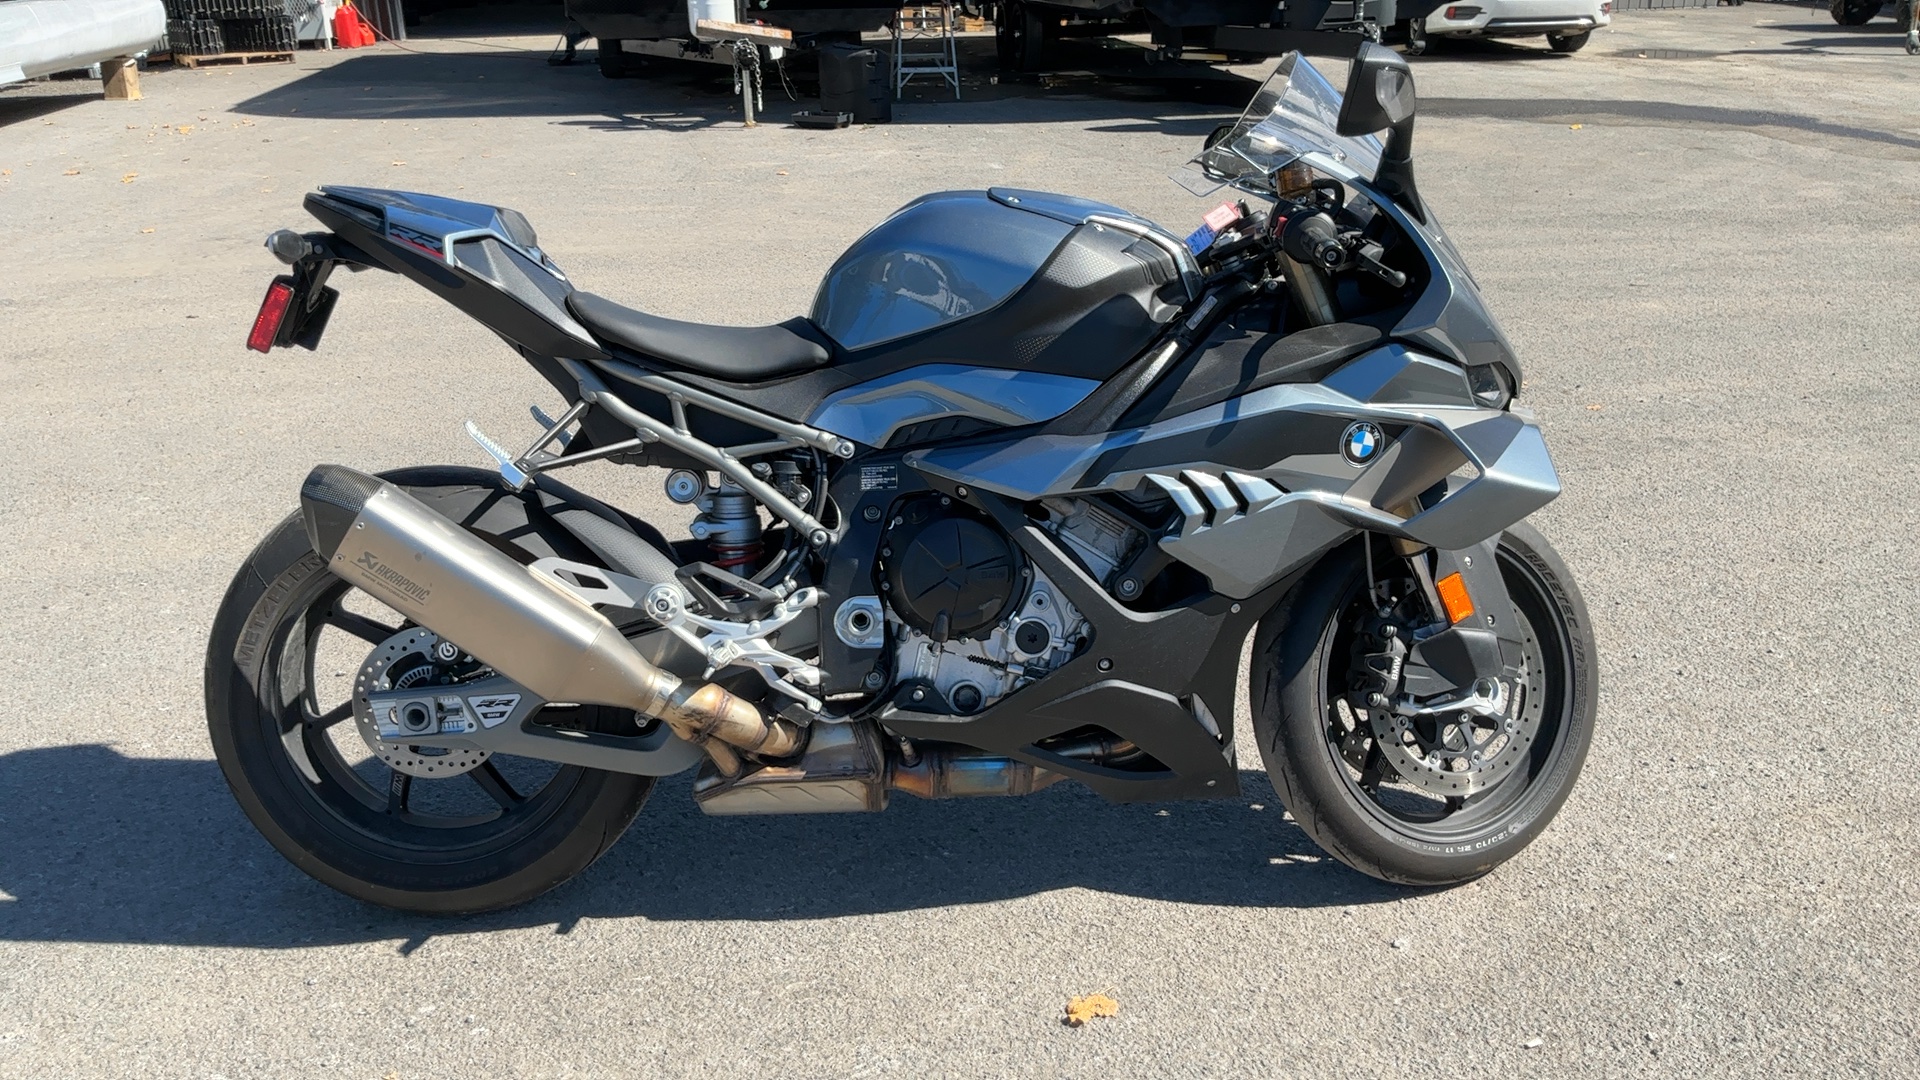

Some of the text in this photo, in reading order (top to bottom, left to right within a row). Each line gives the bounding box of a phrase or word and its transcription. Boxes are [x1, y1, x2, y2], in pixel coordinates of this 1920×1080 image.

[389, 226, 443, 253] RR
[1525, 551, 1585, 663] RACETEC RR
[1390, 655, 1401, 681] BMW
[475, 699, 516, 708] RR
